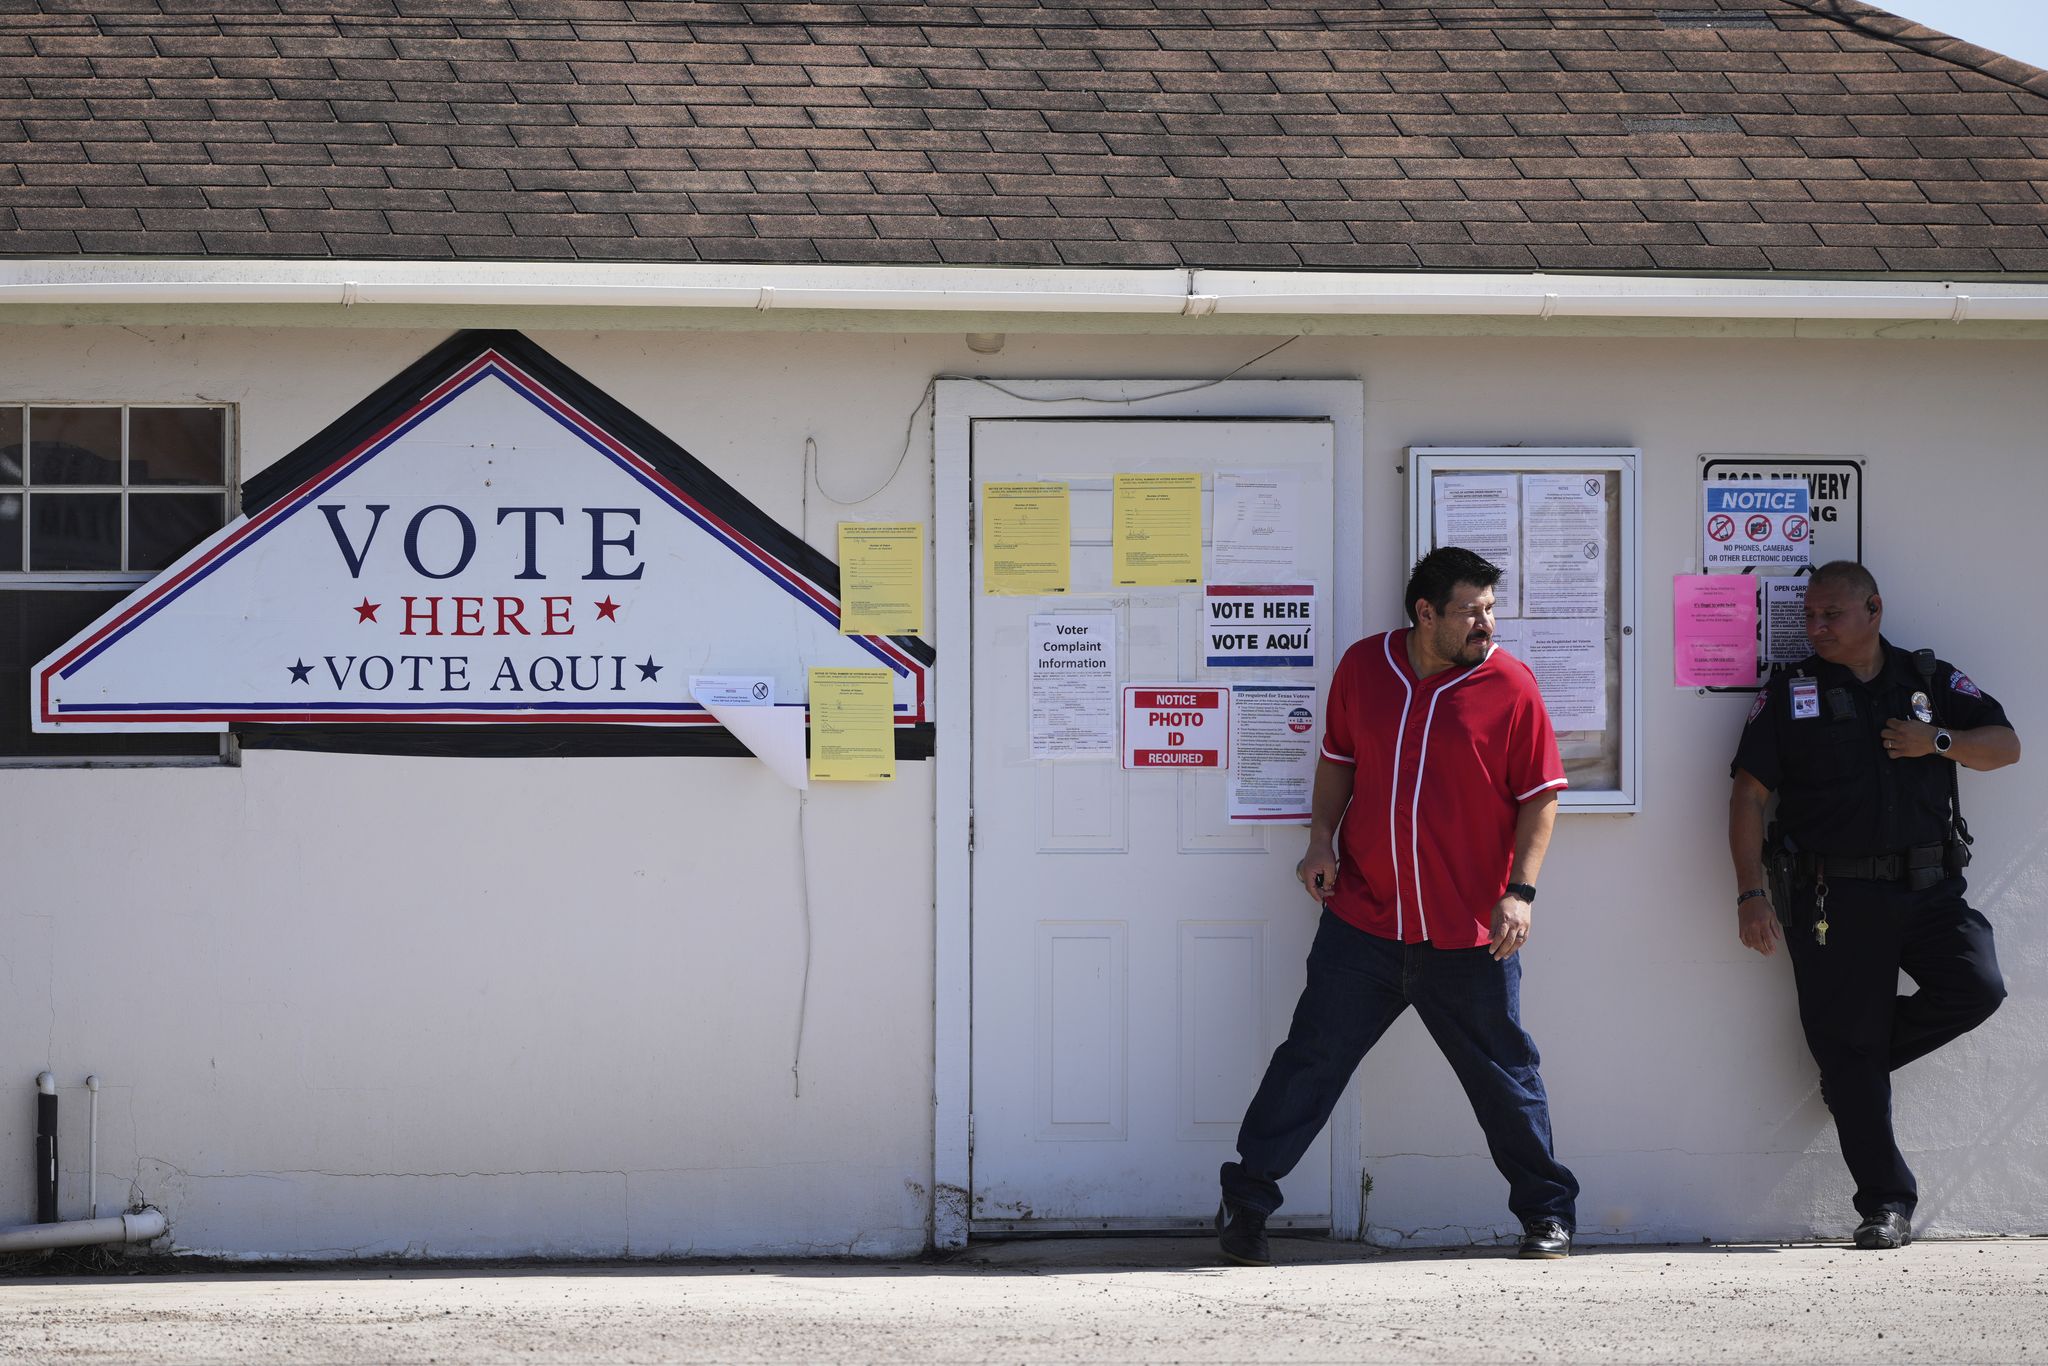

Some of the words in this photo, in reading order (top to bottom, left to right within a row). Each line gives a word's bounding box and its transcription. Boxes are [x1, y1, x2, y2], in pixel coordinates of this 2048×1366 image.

[1722, 492, 1796, 509] NOTICE
[318, 504, 645, 580] VOTE
[400, 595, 576, 637] HERE
[1212, 602, 1255, 619] VOTE
[1263, 602, 1310, 619] HERE
[1056, 624, 1089, 637] Voter
[1212, 633, 1258, 650] VOTE
[1266, 628, 1311, 650] AQUÍ
[1043, 640, 1102, 655] Complaint
[1038, 657, 1107, 669] Information
[323, 656, 470, 692] VOTE
[489, 655, 626, 693] AQUI
[1156, 695, 1197, 705] NOTICE
[1149, 712, 1204, 727] PHOTO
[1168, 732, 1184, 746] ID
[1149, 753, 1203, 763] REQUIRED
